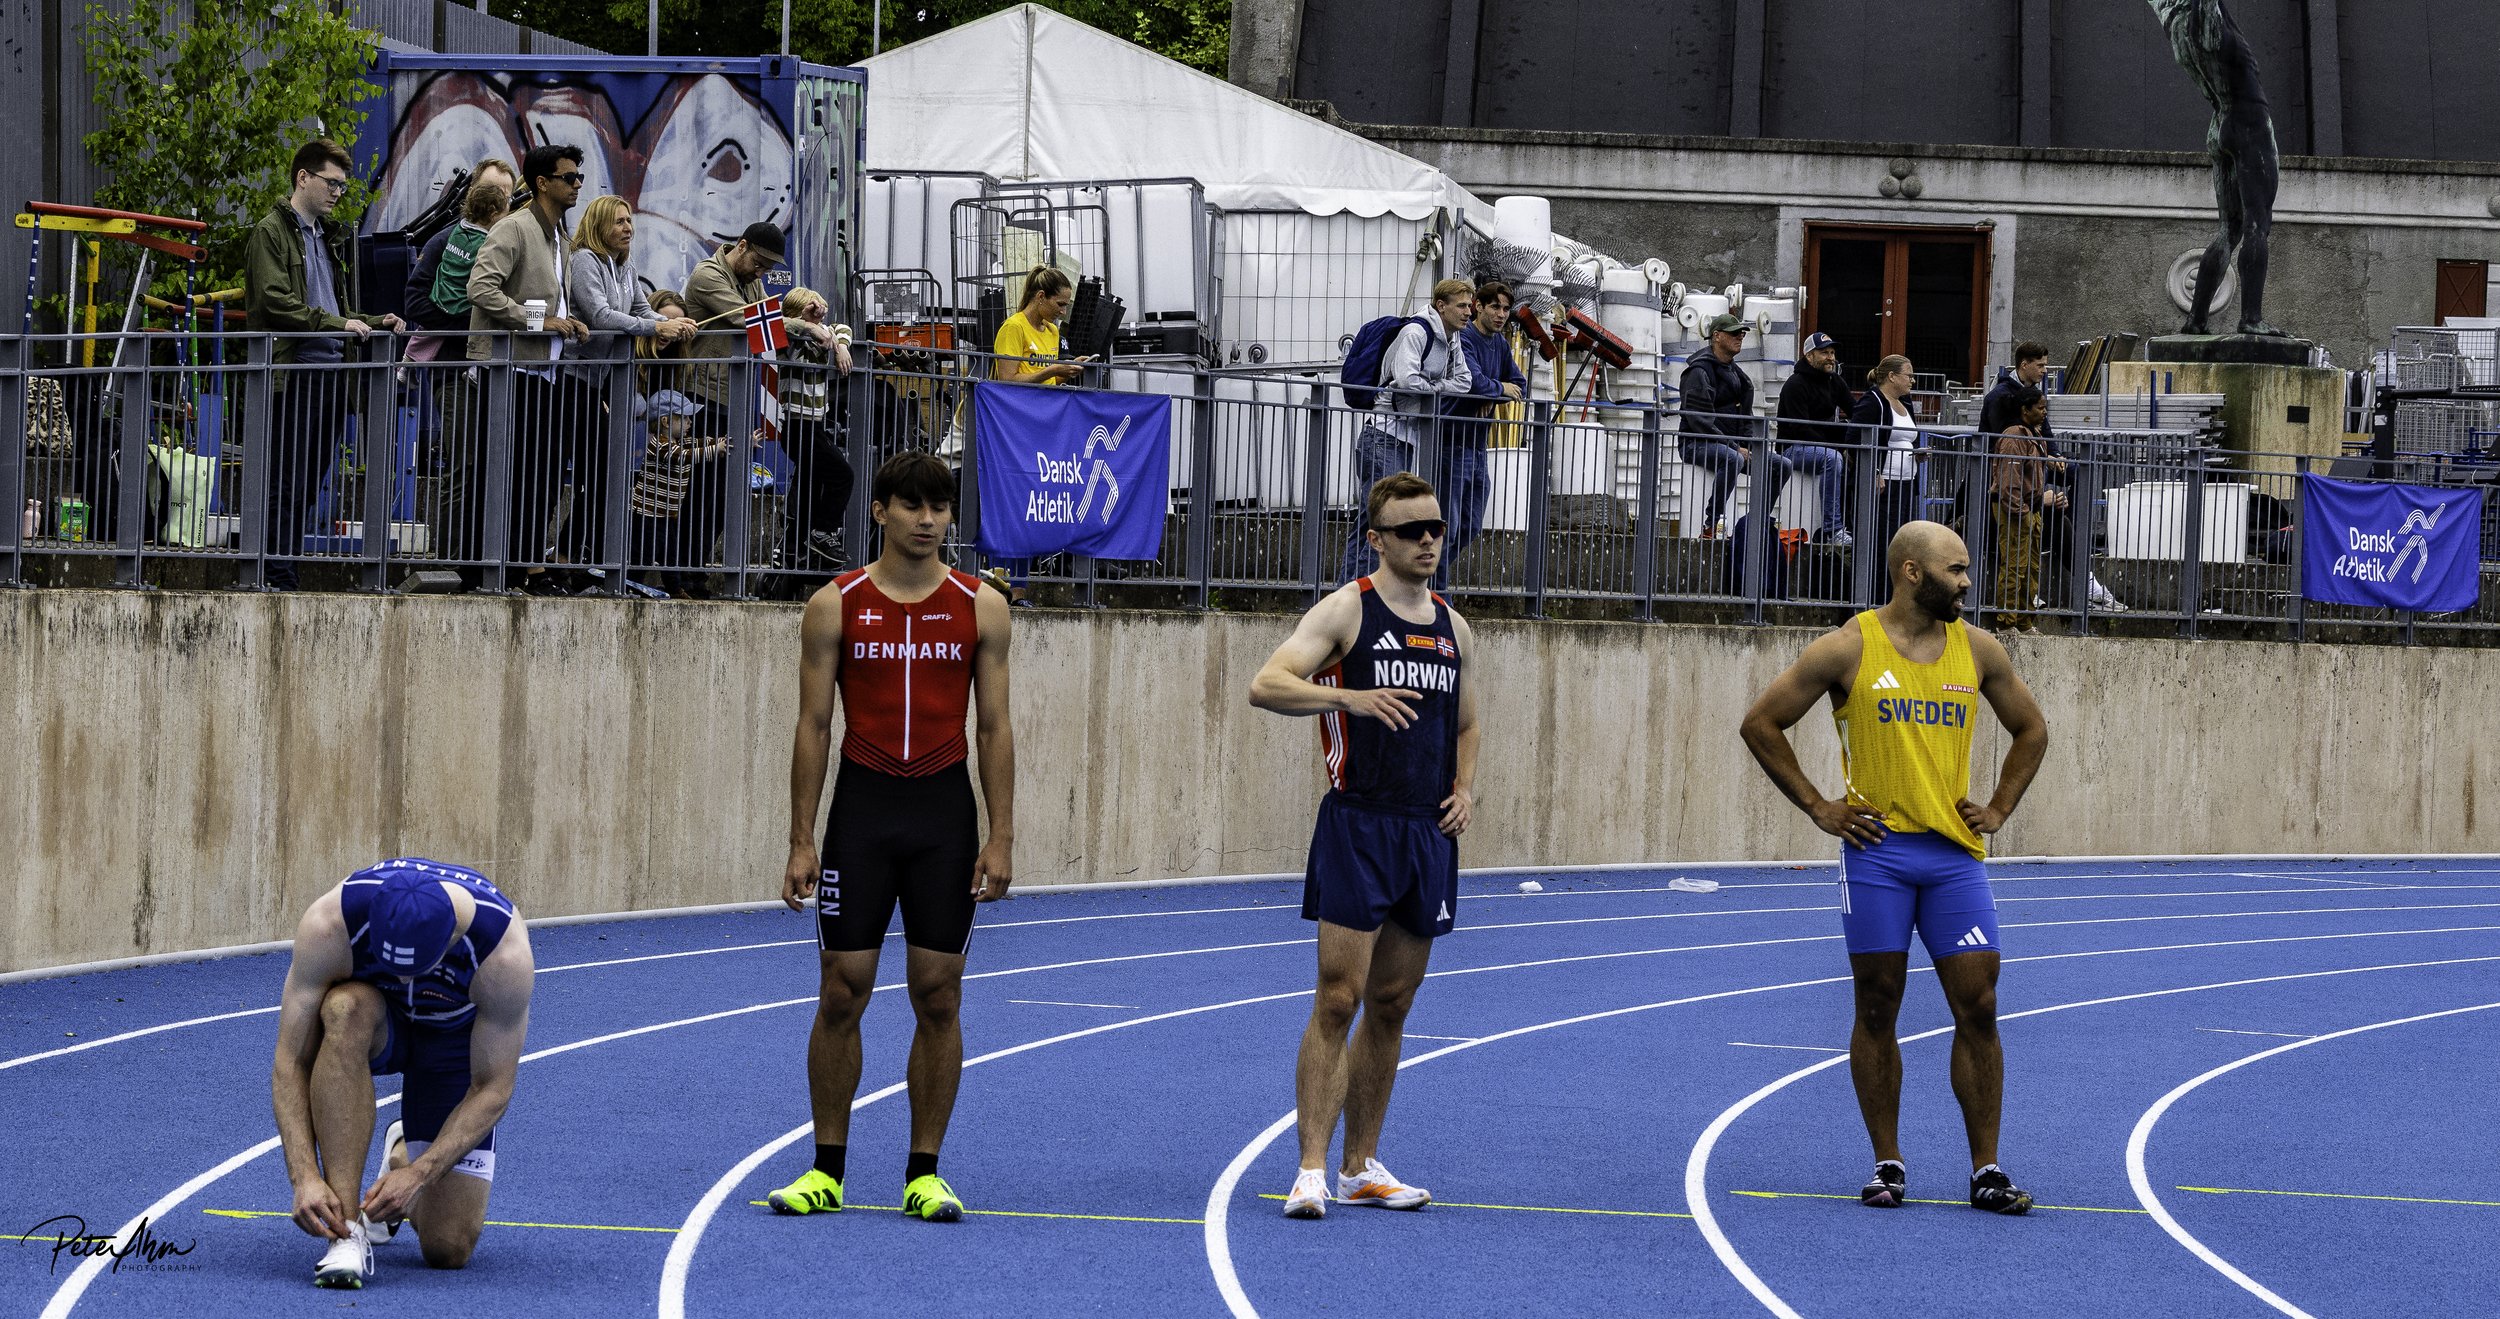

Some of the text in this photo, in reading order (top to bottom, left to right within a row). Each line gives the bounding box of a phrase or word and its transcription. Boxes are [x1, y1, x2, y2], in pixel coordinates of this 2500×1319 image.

[1036, 451, 1084, 485] Dansk
[1025, 490, 1074, 524] Atletik
[2349, 526, 2396, 554] Dansk
[2332, 554, 2386, 583] Atletik
[921, 613, 946, 621] CRAFT
[854, 641, 962, 661] DENMARK
[1417, 639, 1434, 647] EXTRA
[1374, 659, 1457, 694] NORWAY
[1942, 684, 1975, 694] BAUHAUS
[1877, 698, 1967, 729] SWEDEN
[372, 859, 497, 895] FINLAND
[820, 869, 840, 916] DEN
